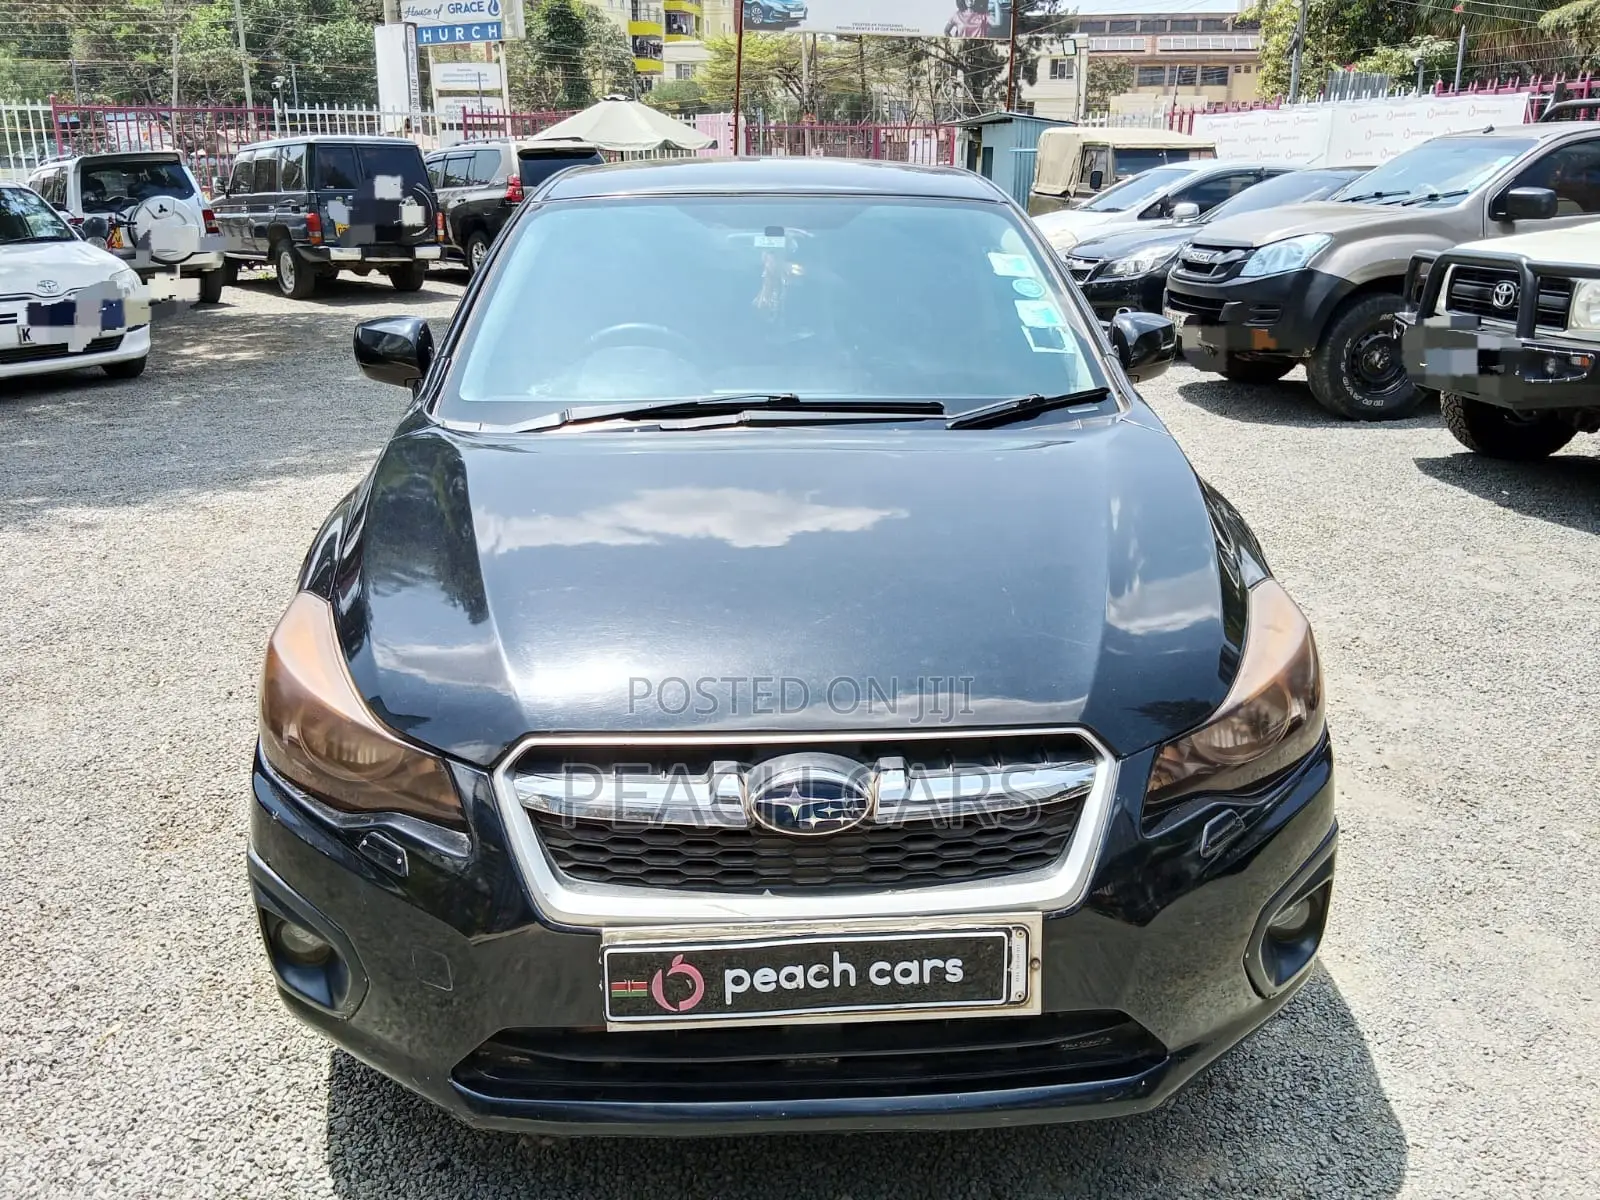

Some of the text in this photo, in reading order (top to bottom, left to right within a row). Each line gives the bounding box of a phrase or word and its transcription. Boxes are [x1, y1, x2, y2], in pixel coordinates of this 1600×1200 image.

[404, 1, 485, 19] House of GRACE
[422, 24, 498, 42] HURCH
[724, 951, 856, 1005] peach
[868, 955, 964, 986] cars
